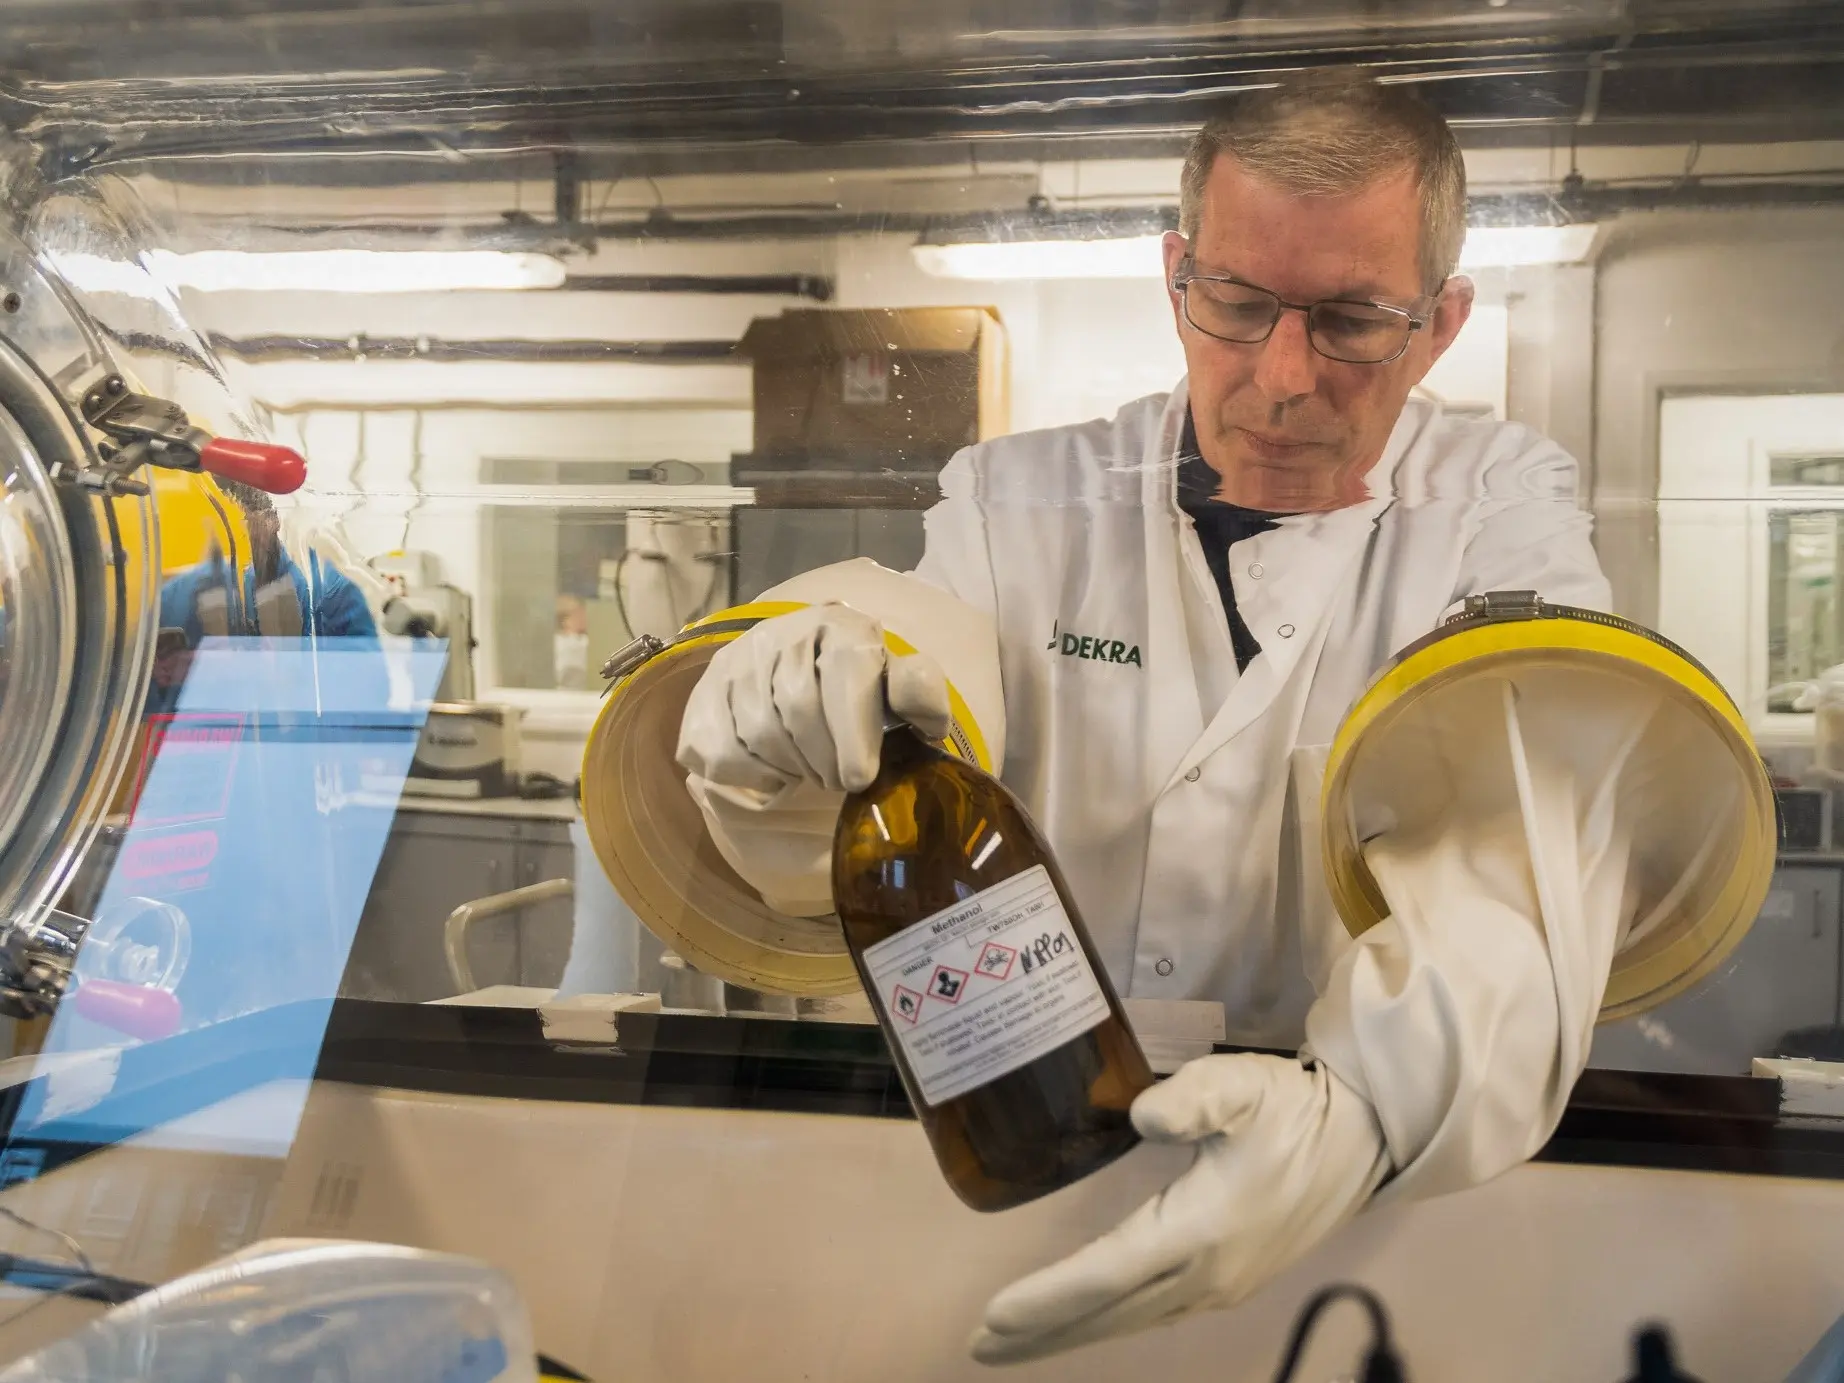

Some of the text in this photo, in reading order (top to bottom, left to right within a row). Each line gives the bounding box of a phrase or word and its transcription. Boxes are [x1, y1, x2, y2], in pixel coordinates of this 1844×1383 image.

[1061, 633, 1142, 669] DEKRA
[931, 903, 983, 934] Methanol
[903, 956, 934, 976] DANGER
